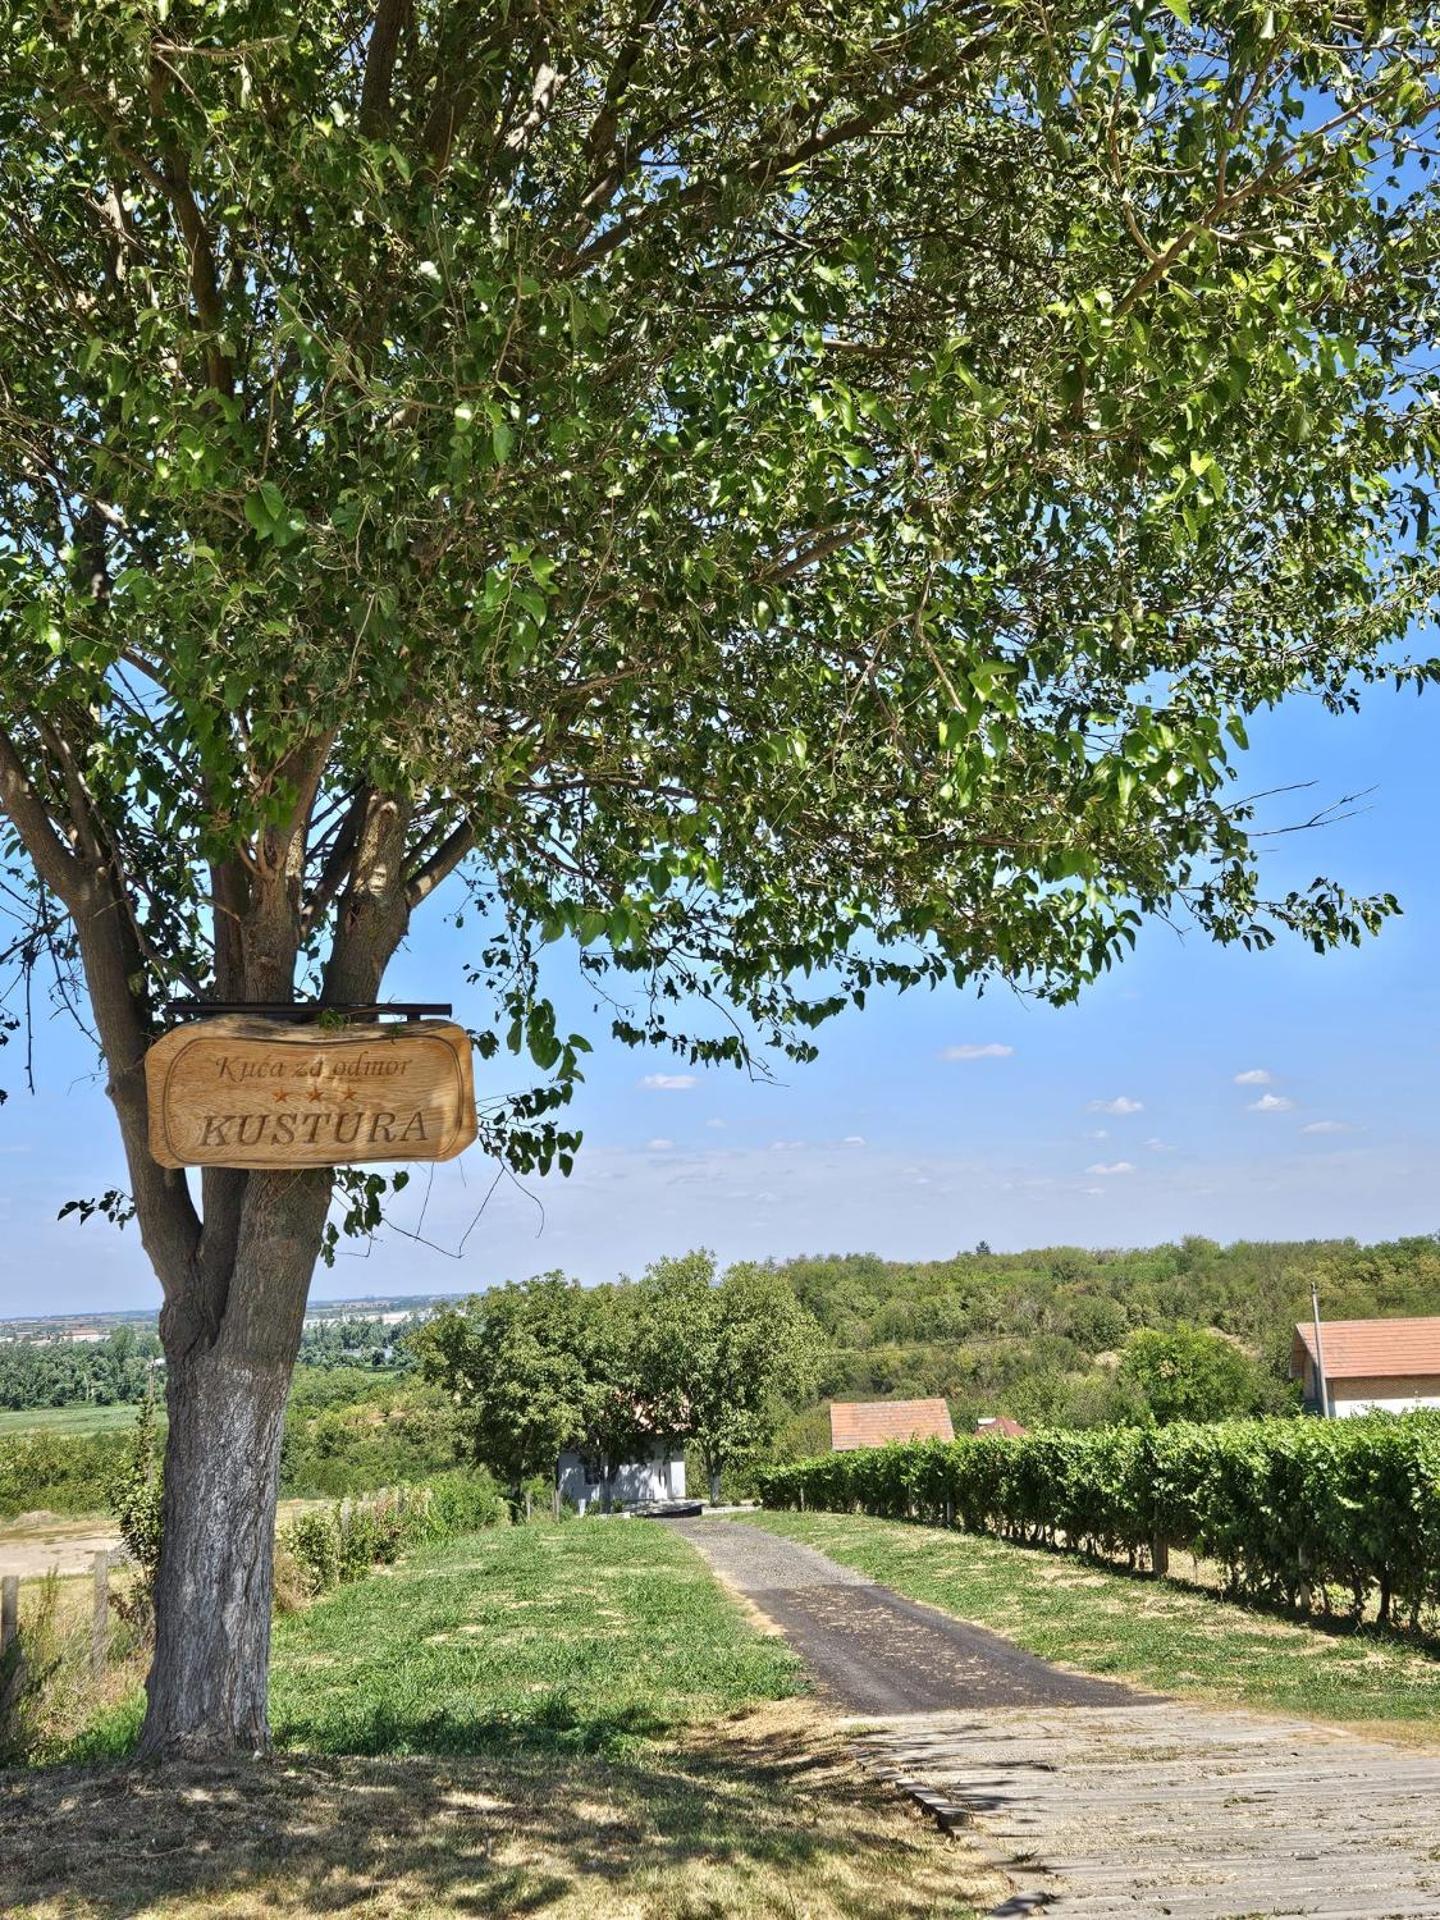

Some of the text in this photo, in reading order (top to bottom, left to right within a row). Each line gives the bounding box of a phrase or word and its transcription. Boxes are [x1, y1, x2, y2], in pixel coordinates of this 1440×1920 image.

[216, 1051, 412, 1082] Kuća za odmor
[200, 1111, 428, 1147] KUSTURA
